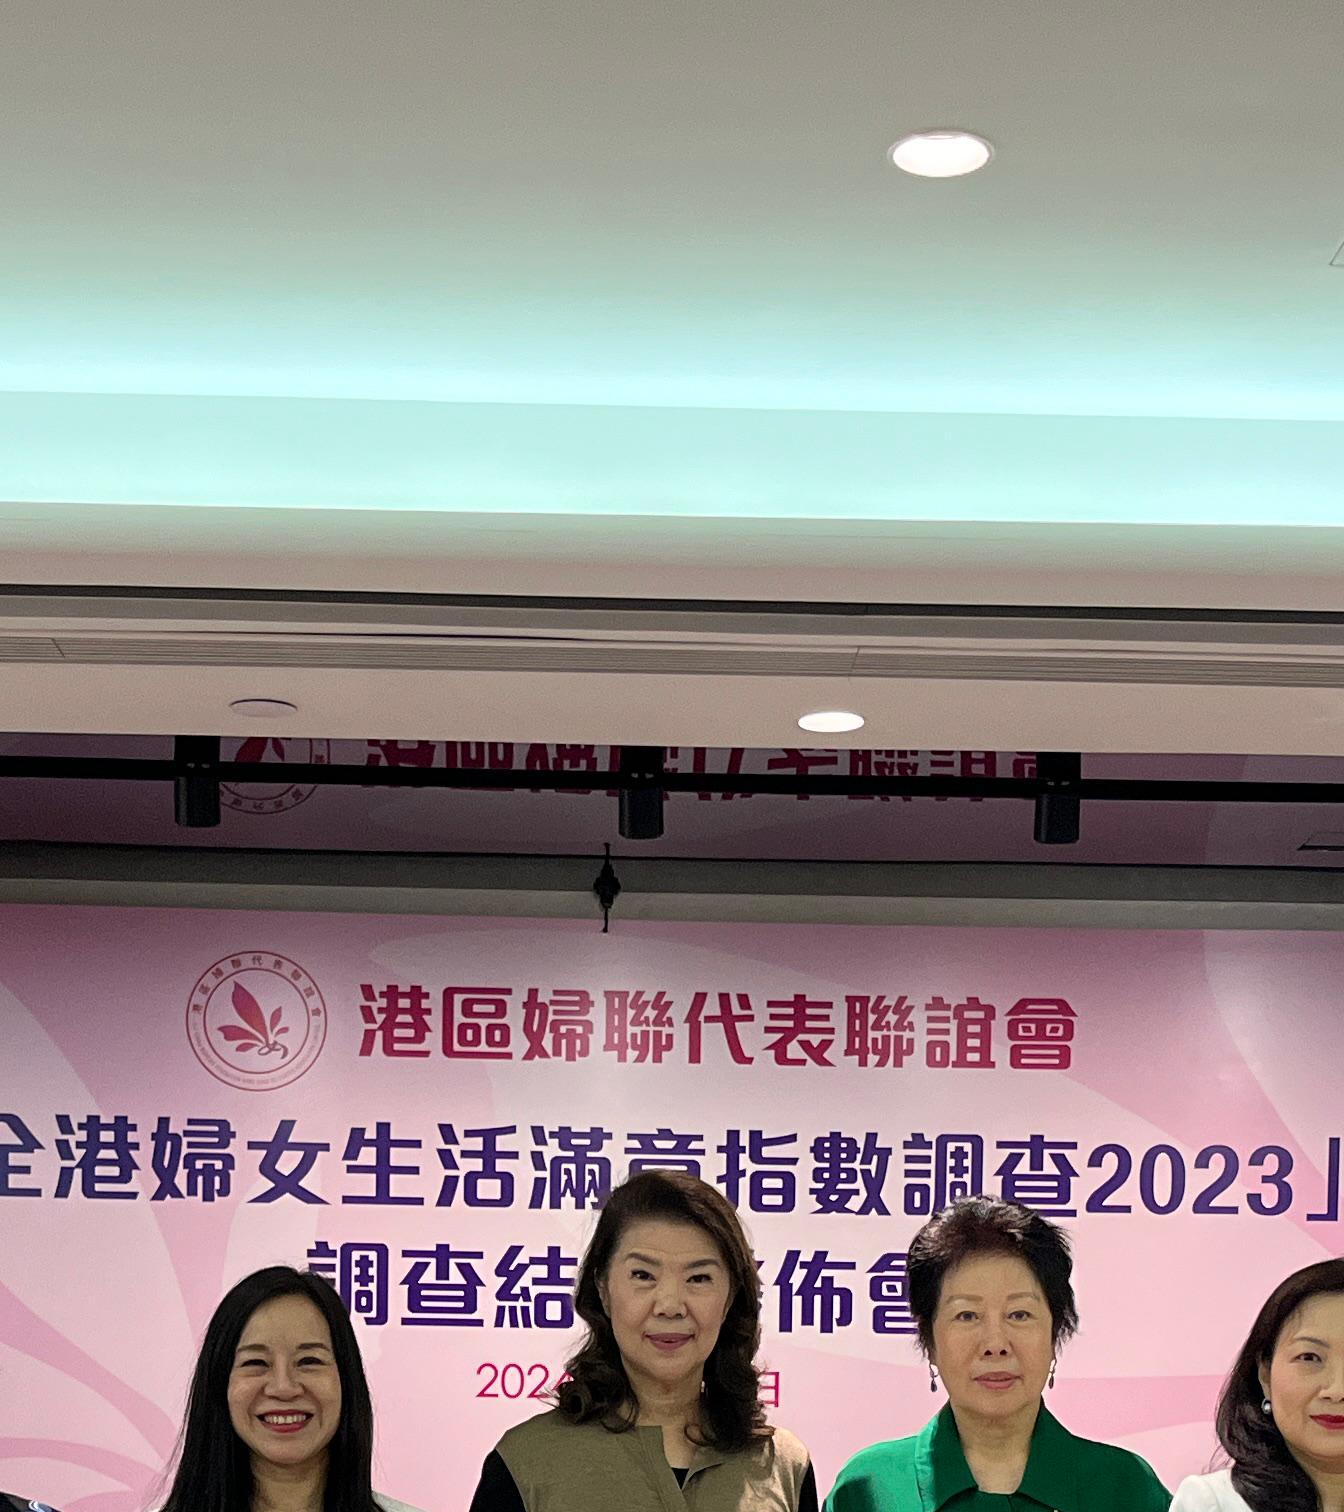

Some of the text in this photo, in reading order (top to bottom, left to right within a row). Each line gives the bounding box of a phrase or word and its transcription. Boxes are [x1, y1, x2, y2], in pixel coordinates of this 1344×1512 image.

[358, 983, 1079, 1071] 港區婦聯代表聯誼會
[306, 1240, 919, 1335] 調查結佈會
